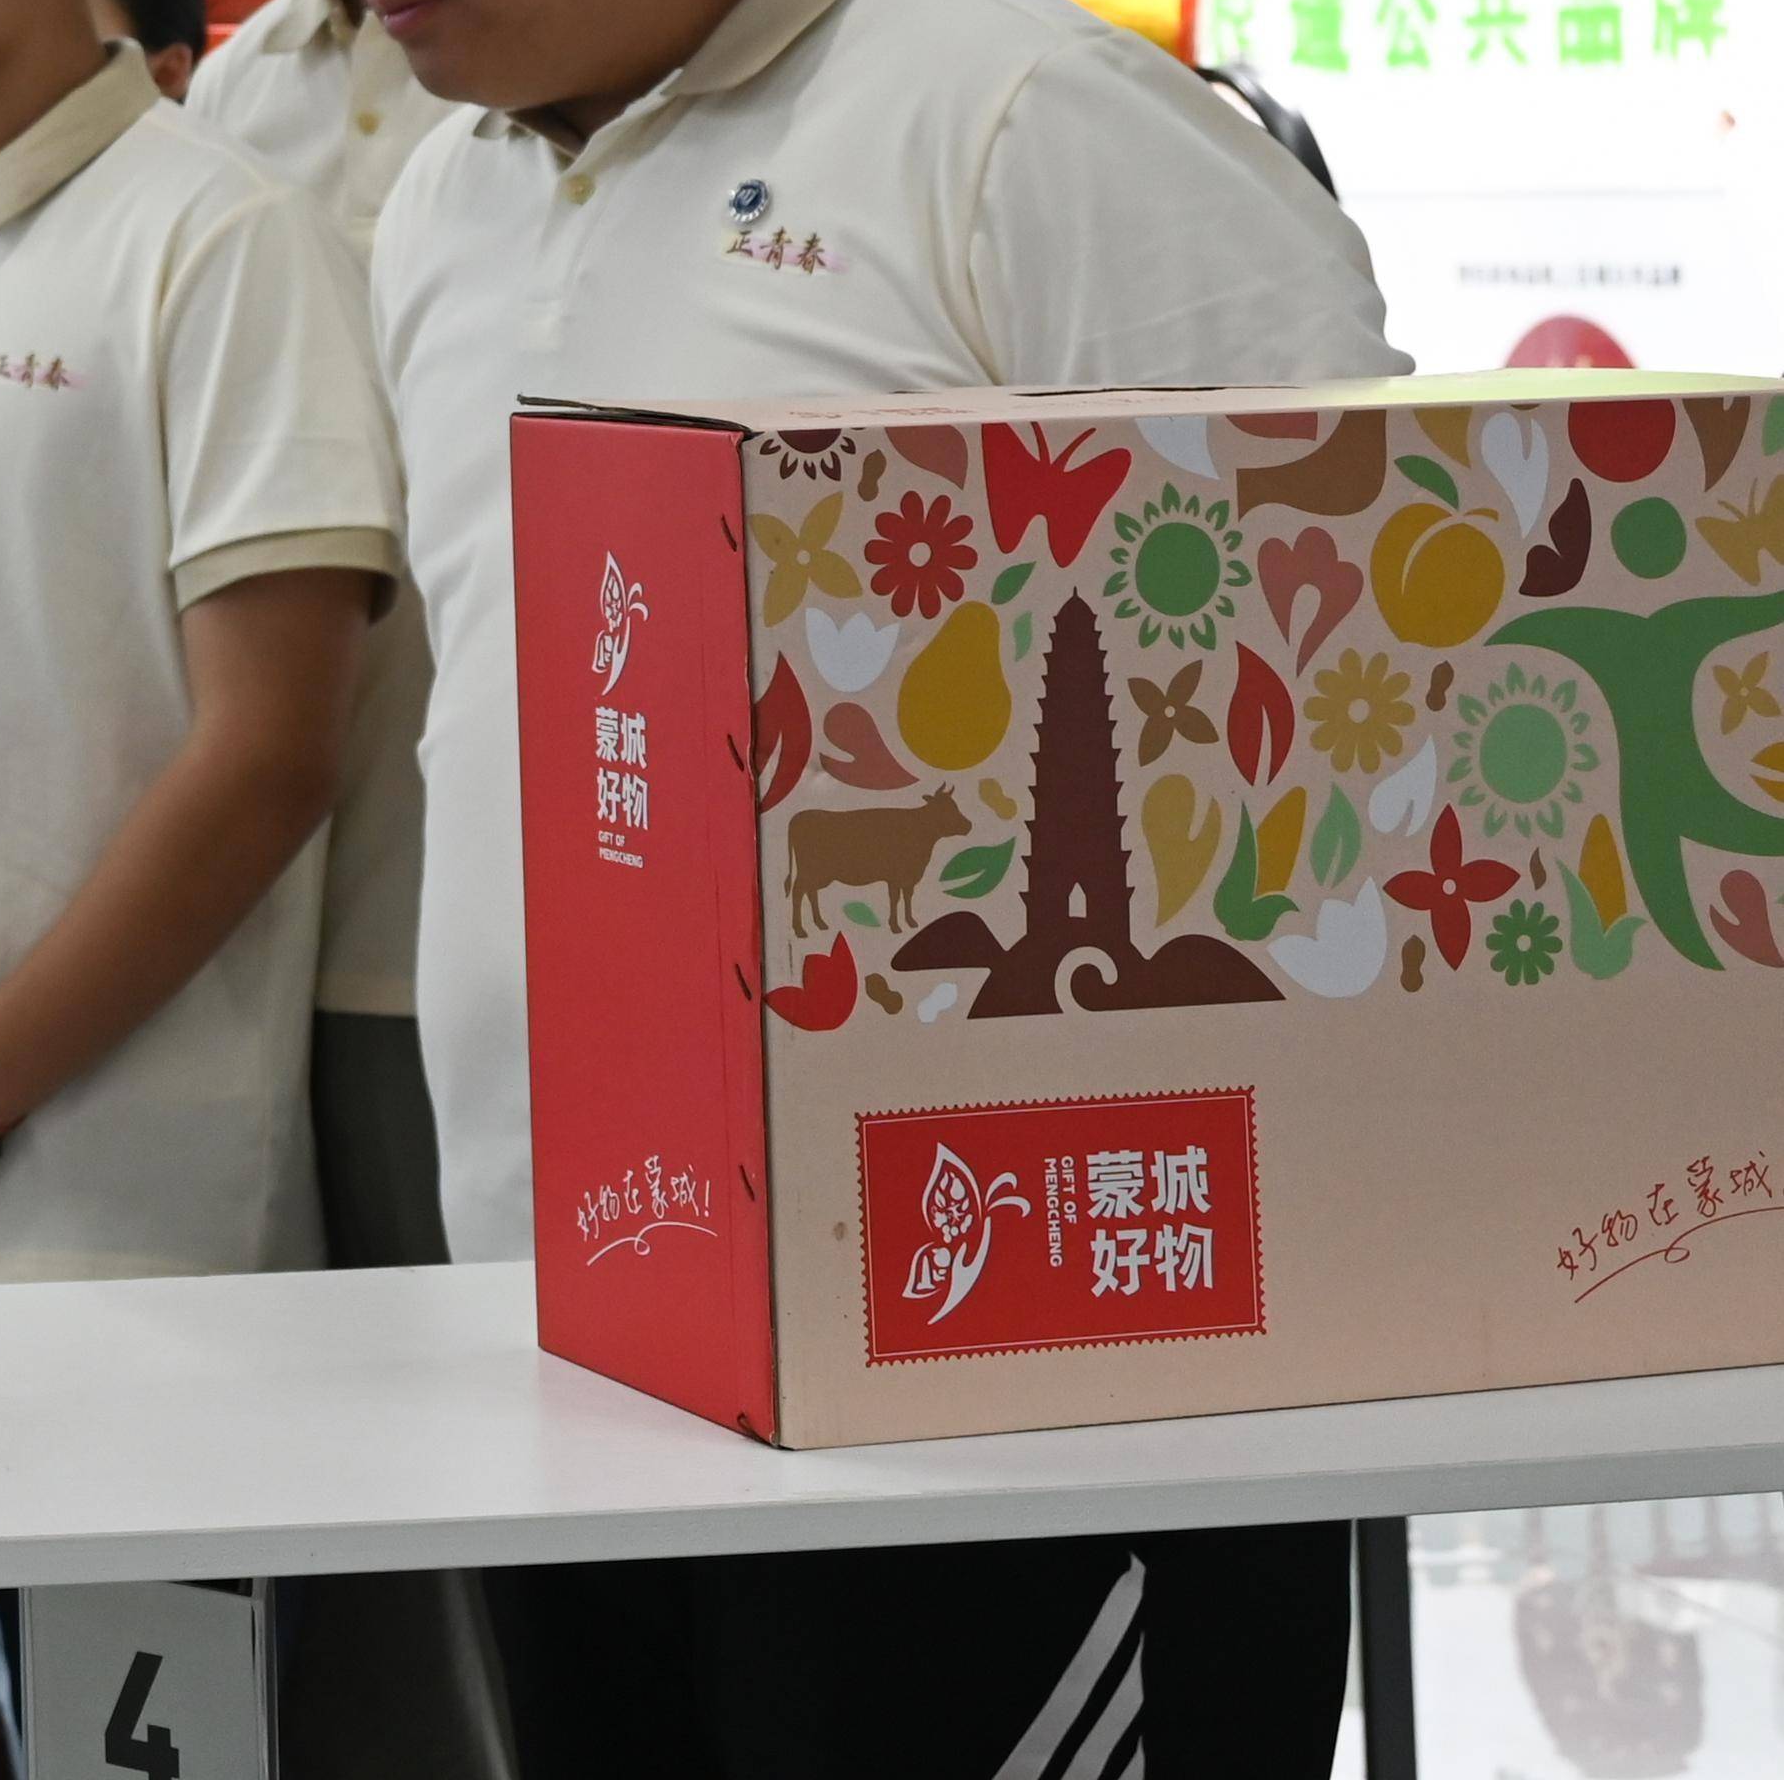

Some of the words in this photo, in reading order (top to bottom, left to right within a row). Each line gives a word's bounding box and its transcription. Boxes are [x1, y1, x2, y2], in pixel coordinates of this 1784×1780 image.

[726, 226, 826, 275] 正青春
[595, 706, 648, 769] 蒙城
[596, 767, 649, 831] 好物
[598, 830, 614, 845] GIFT
[615, 834, 626, 847] OF
[599, 847, 644, 869] MENGCHENG
[1060, 1154, 1076, 1195] GIFT
[1085, 1145, 1213, 1220] 蒙城
[1043, 1157, 1063, 1268] MENGCHENG
[1062, 1203, 1078, 1226] OF
[1556, 1151, 1784, 1281] 好物在蒙城
[1089, 1222, 1214, 1299] 好物
[104, 1650, 180, 1780] 4
